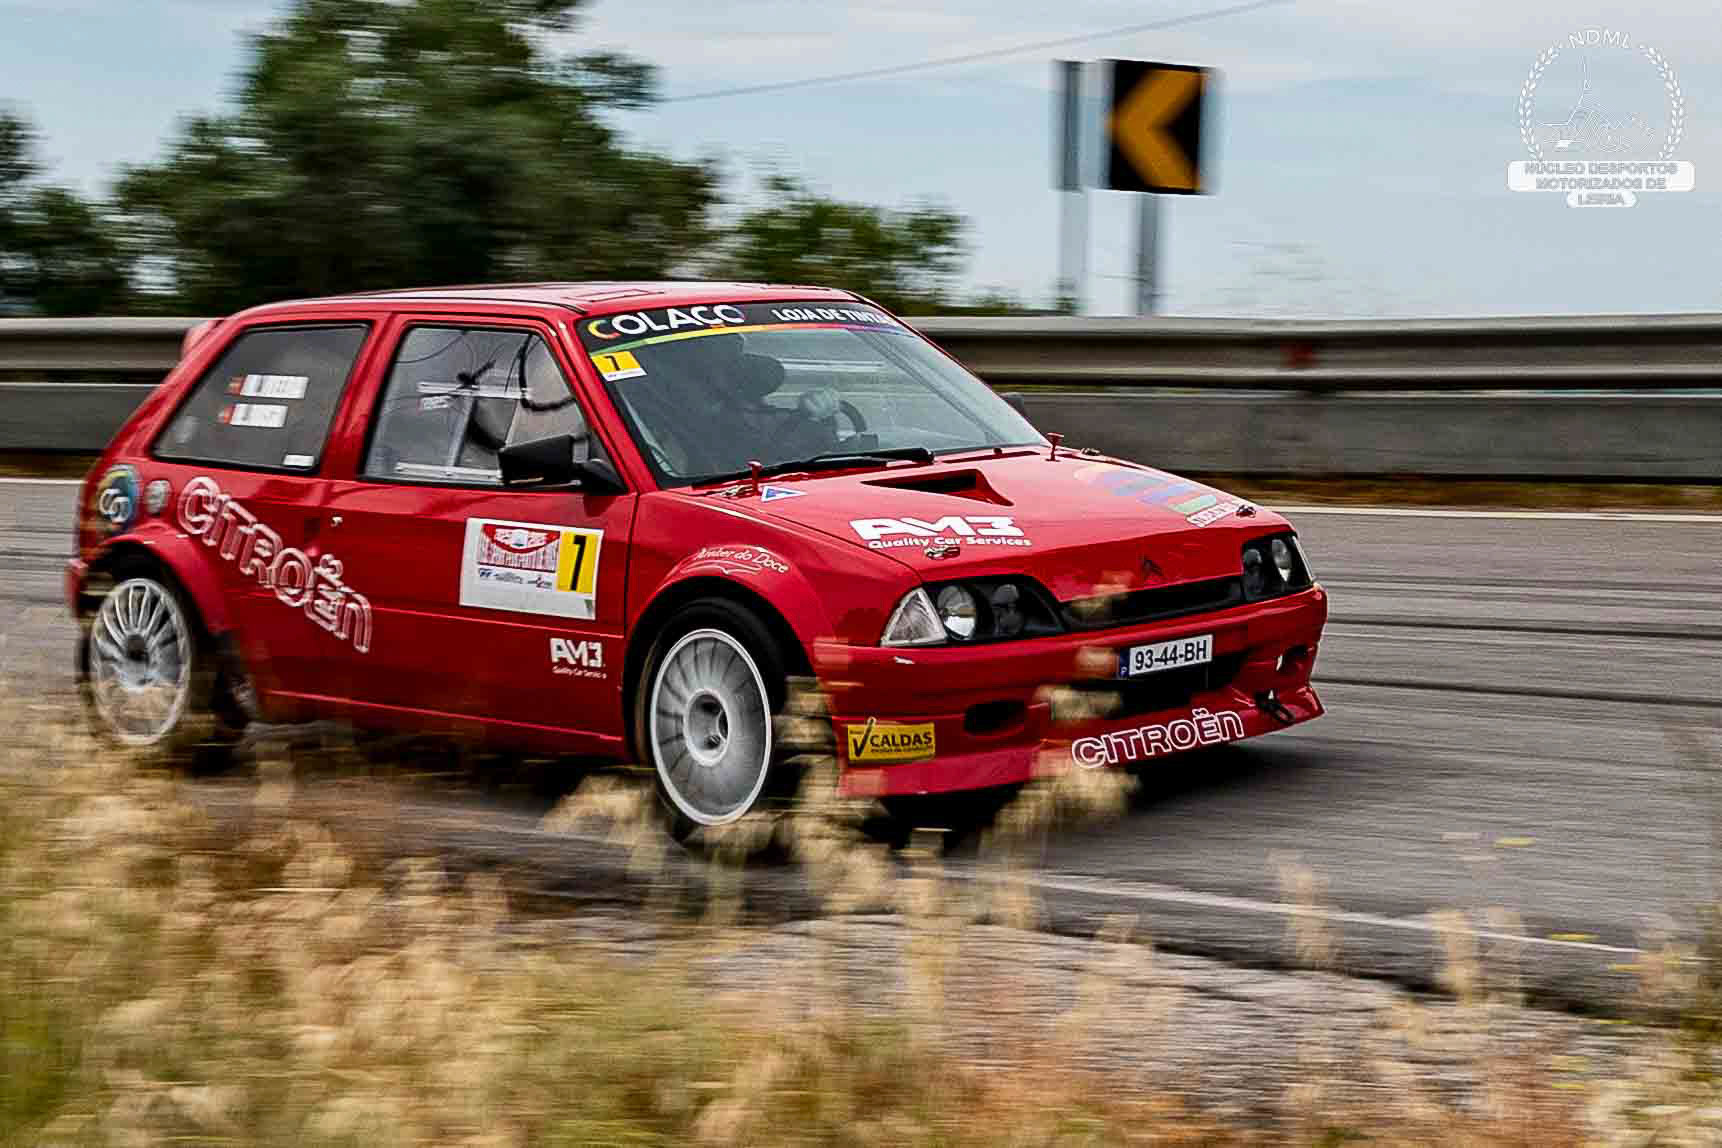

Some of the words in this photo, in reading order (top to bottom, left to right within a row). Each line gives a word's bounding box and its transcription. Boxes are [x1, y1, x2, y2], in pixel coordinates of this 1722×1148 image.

[771, 308, 821, 321] LOJA
[816, 308, 848, 321] DE
[604, 355, 621, 372] 1
[849, 515, 1025, 541] AM3
[868, 537, 930, 550] Quality
[934, 535, 963, 546] Car
[966, 535, 1033, 547] Services
[570, 535, 587, 591] 1
[734, 550, 753, 561] do
[752, 553, 789, 573] Doce
[550, 638, 602, 668] AM3
[1135, 639, 1207, 671] 93-44-BH
[870, 731, 932, 747] CALDAS
